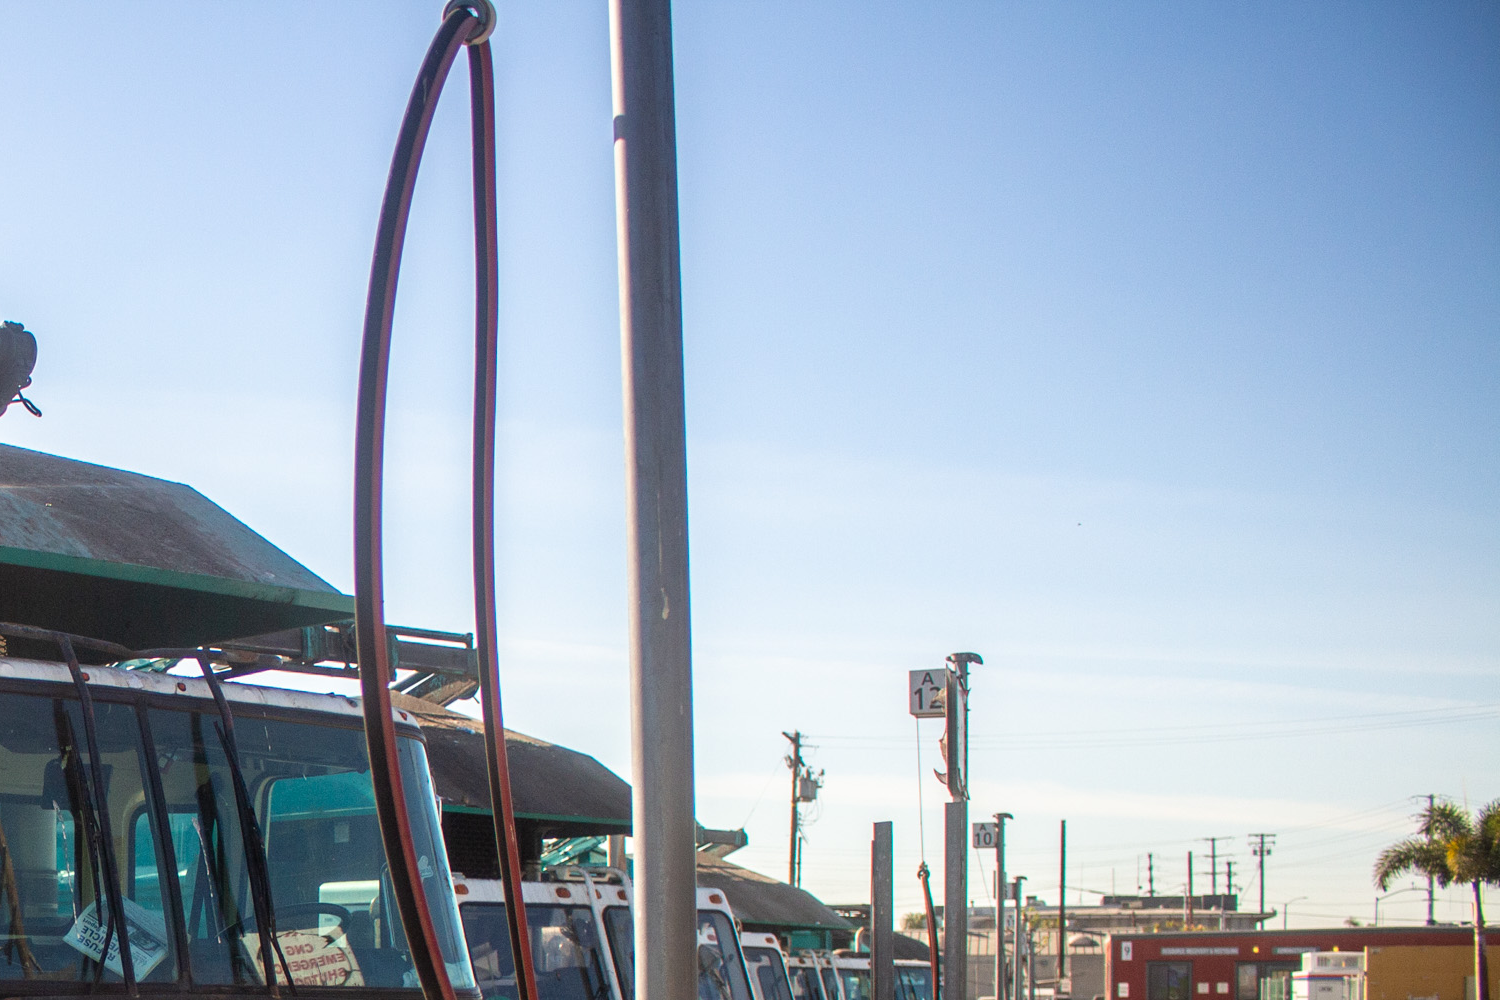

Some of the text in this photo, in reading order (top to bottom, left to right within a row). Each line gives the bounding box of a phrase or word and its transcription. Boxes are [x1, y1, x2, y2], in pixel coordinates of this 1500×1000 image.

[921, 672, 934, 685] A
[914, 686, 942, 710] 12
[975, 832, 992, 846] 10
[77, 934, 116, 962] RFUSE
[81, 925, 120, 955] VEICLE
